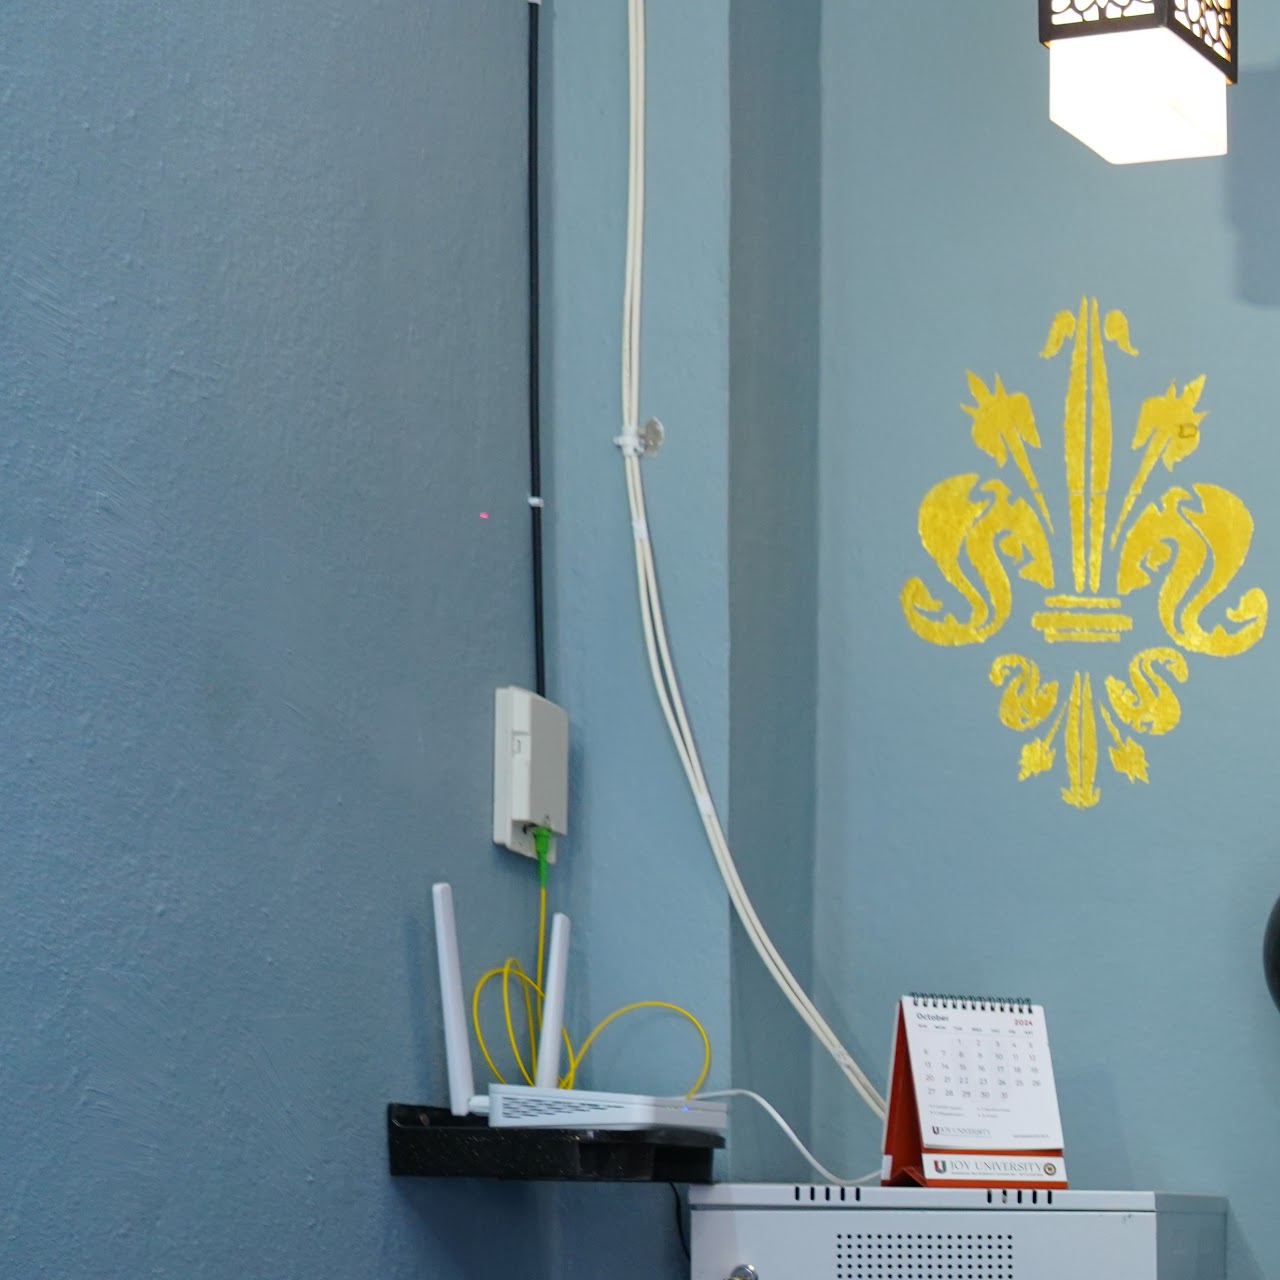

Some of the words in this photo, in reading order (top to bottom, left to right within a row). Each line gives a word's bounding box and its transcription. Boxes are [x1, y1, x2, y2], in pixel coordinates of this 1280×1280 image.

[916, 1012, 949, 1022] October
[1014, 1018, 1033, 1027] 2024
[975, 1161, 1042, 1172] UNIVERSITY
